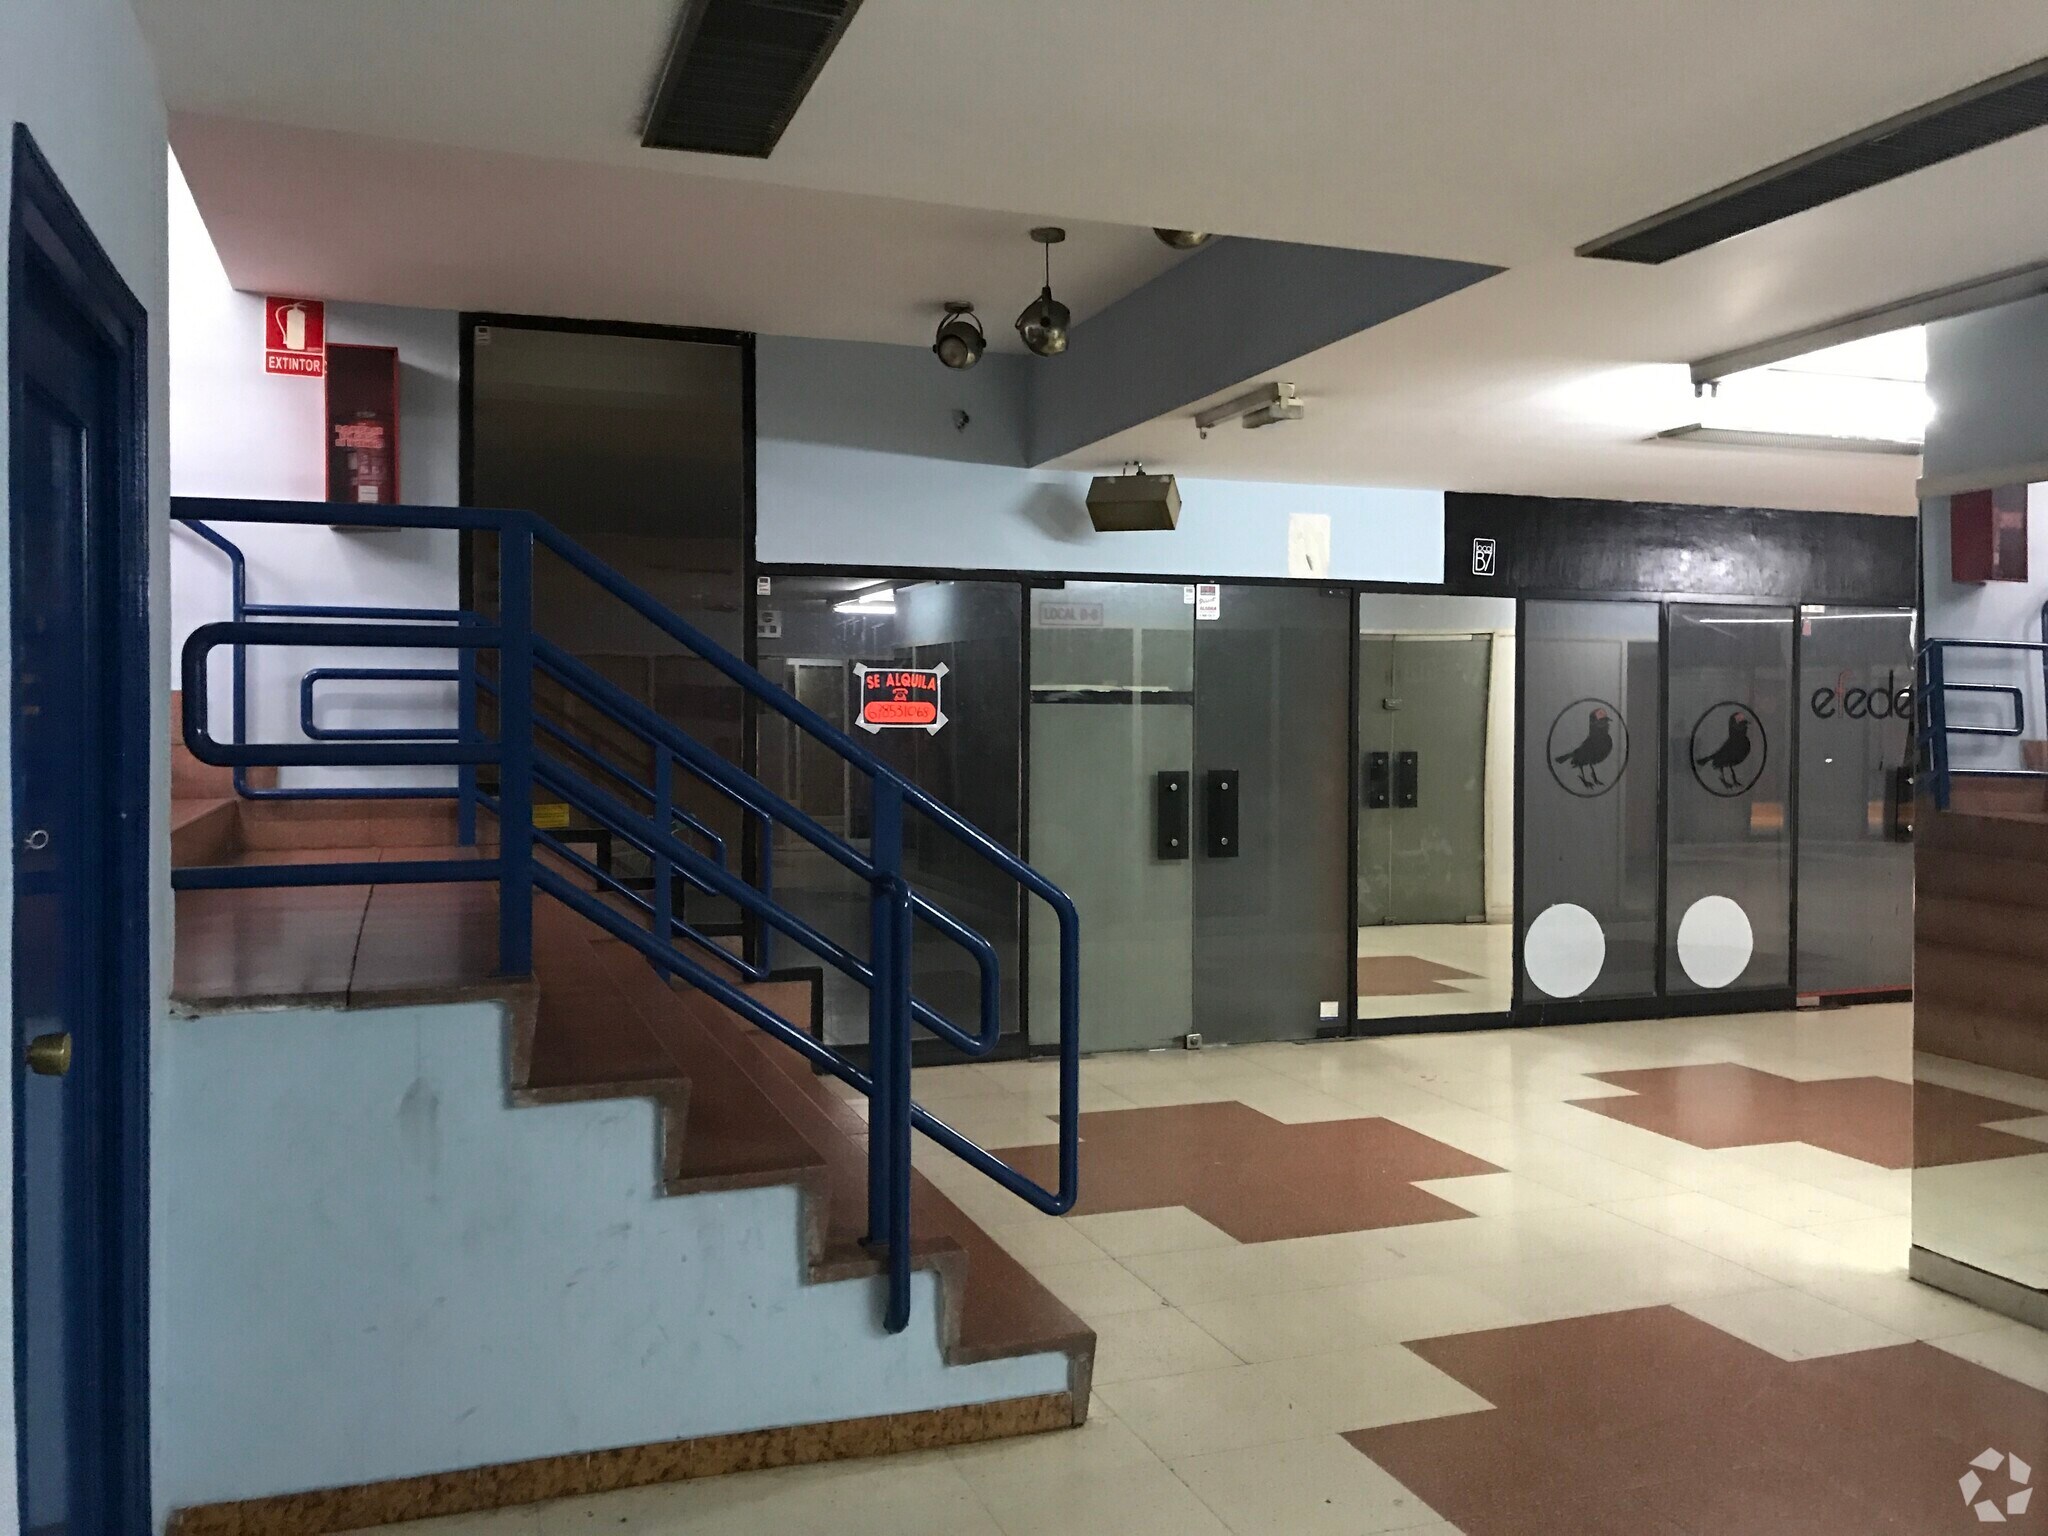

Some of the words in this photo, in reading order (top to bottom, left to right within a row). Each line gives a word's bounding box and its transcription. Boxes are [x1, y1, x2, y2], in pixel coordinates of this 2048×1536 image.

[268, 356, 322, 373] EXTINTOR
[1475, 550, 1493, 572] B7
[1043, 608, 1077, 621] LOCAL
[866, 673, 881, 690] SE
[885, 672, 936, 691] ALQUILA
